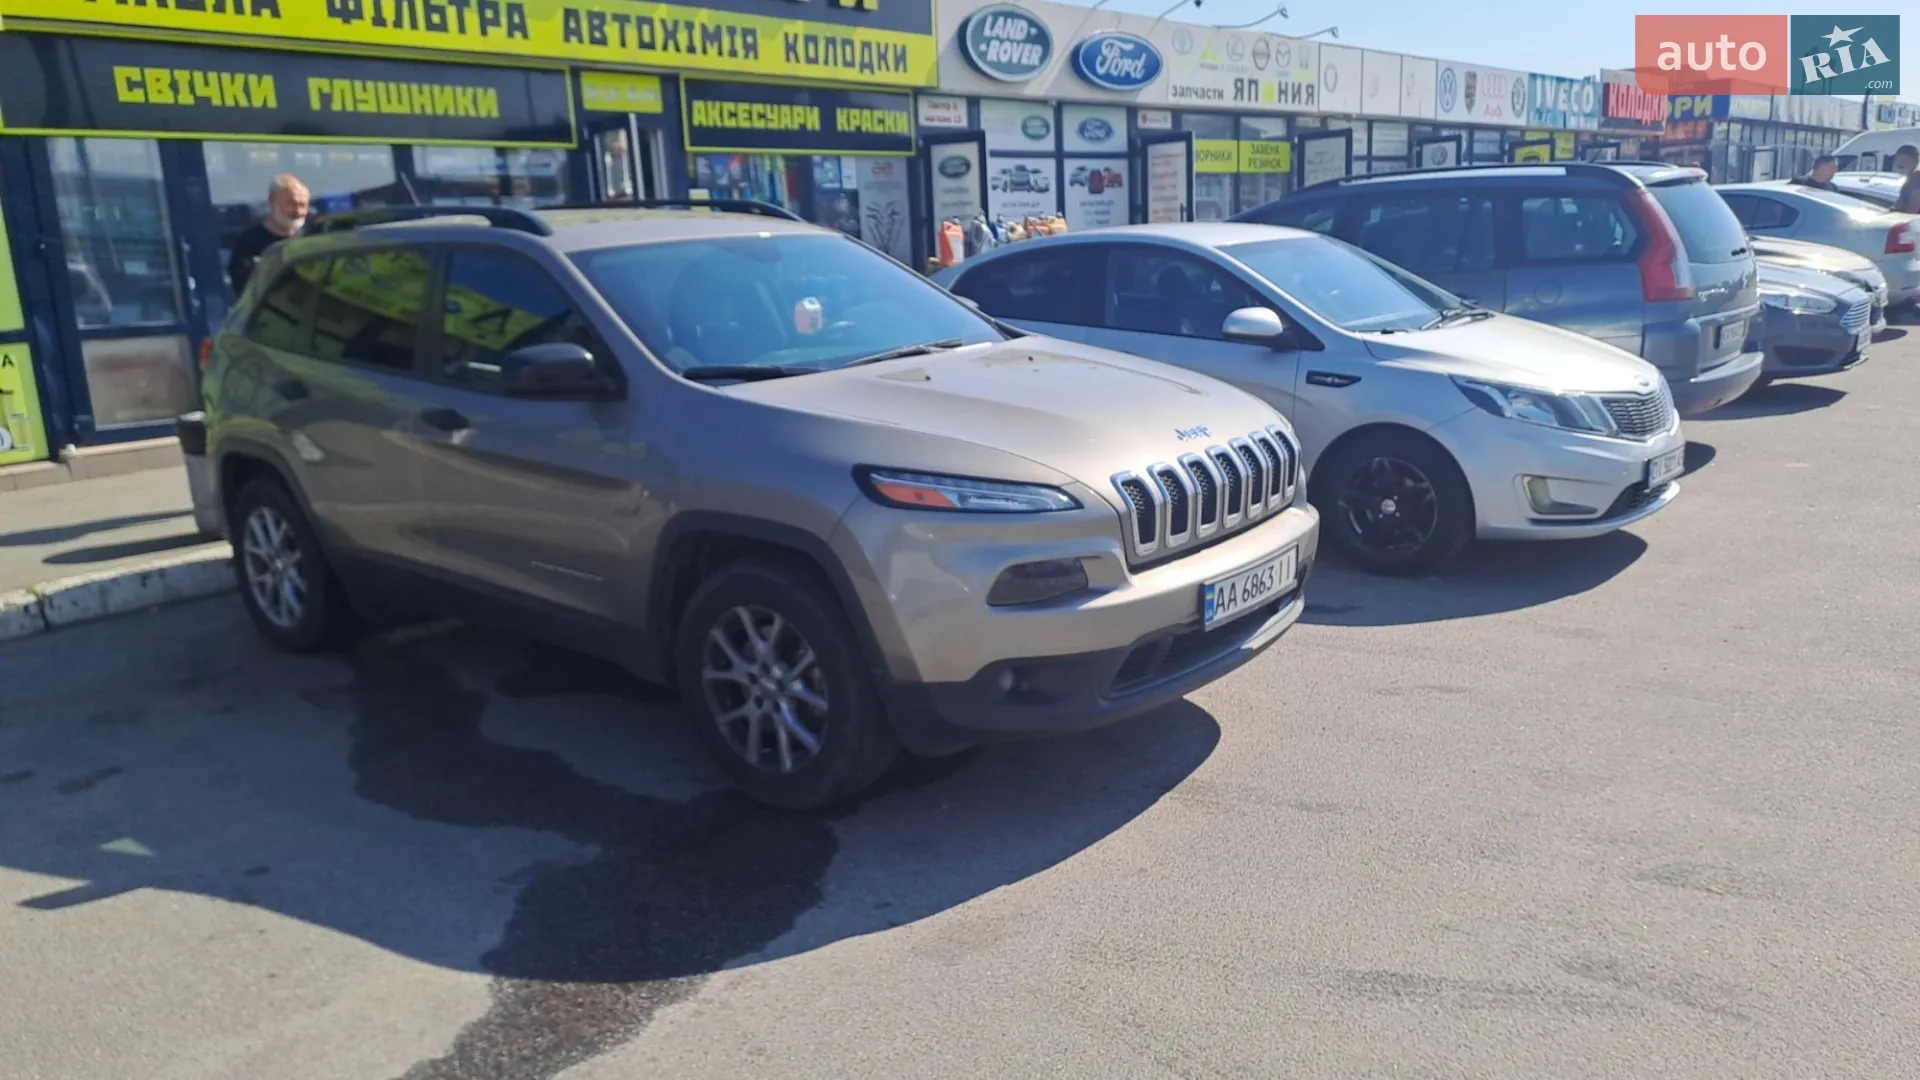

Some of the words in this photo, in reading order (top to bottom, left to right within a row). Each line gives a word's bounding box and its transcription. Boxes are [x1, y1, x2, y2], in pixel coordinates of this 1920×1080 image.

[562, 8, 759, 60] АВТОХІМІЯ
[784, 32, 909, 75] КОЛОДКИ
[983, 15, 1028, 40] LAND
[986, 40, 1043, 66] ROVER
[1095, 38, 1146, 79] Ford
[113, 66, 277, 108] СВІЧКИ
[307, 77, 499, 118] ГЛУШНИКИ
[1171, 84, 1224, 100] запчасти
[1234, 78, 1315, 106] ЯПОНИЯ
[1535, 76, 1595, 114] IVECO
[692, 99, 821, 131] АКСЕСУАРИ
[835, 107, 909, 135] КРАСКИ
[1214, 581, 1238, 615] AA
[1242, 567, 1274, 602] 6863
